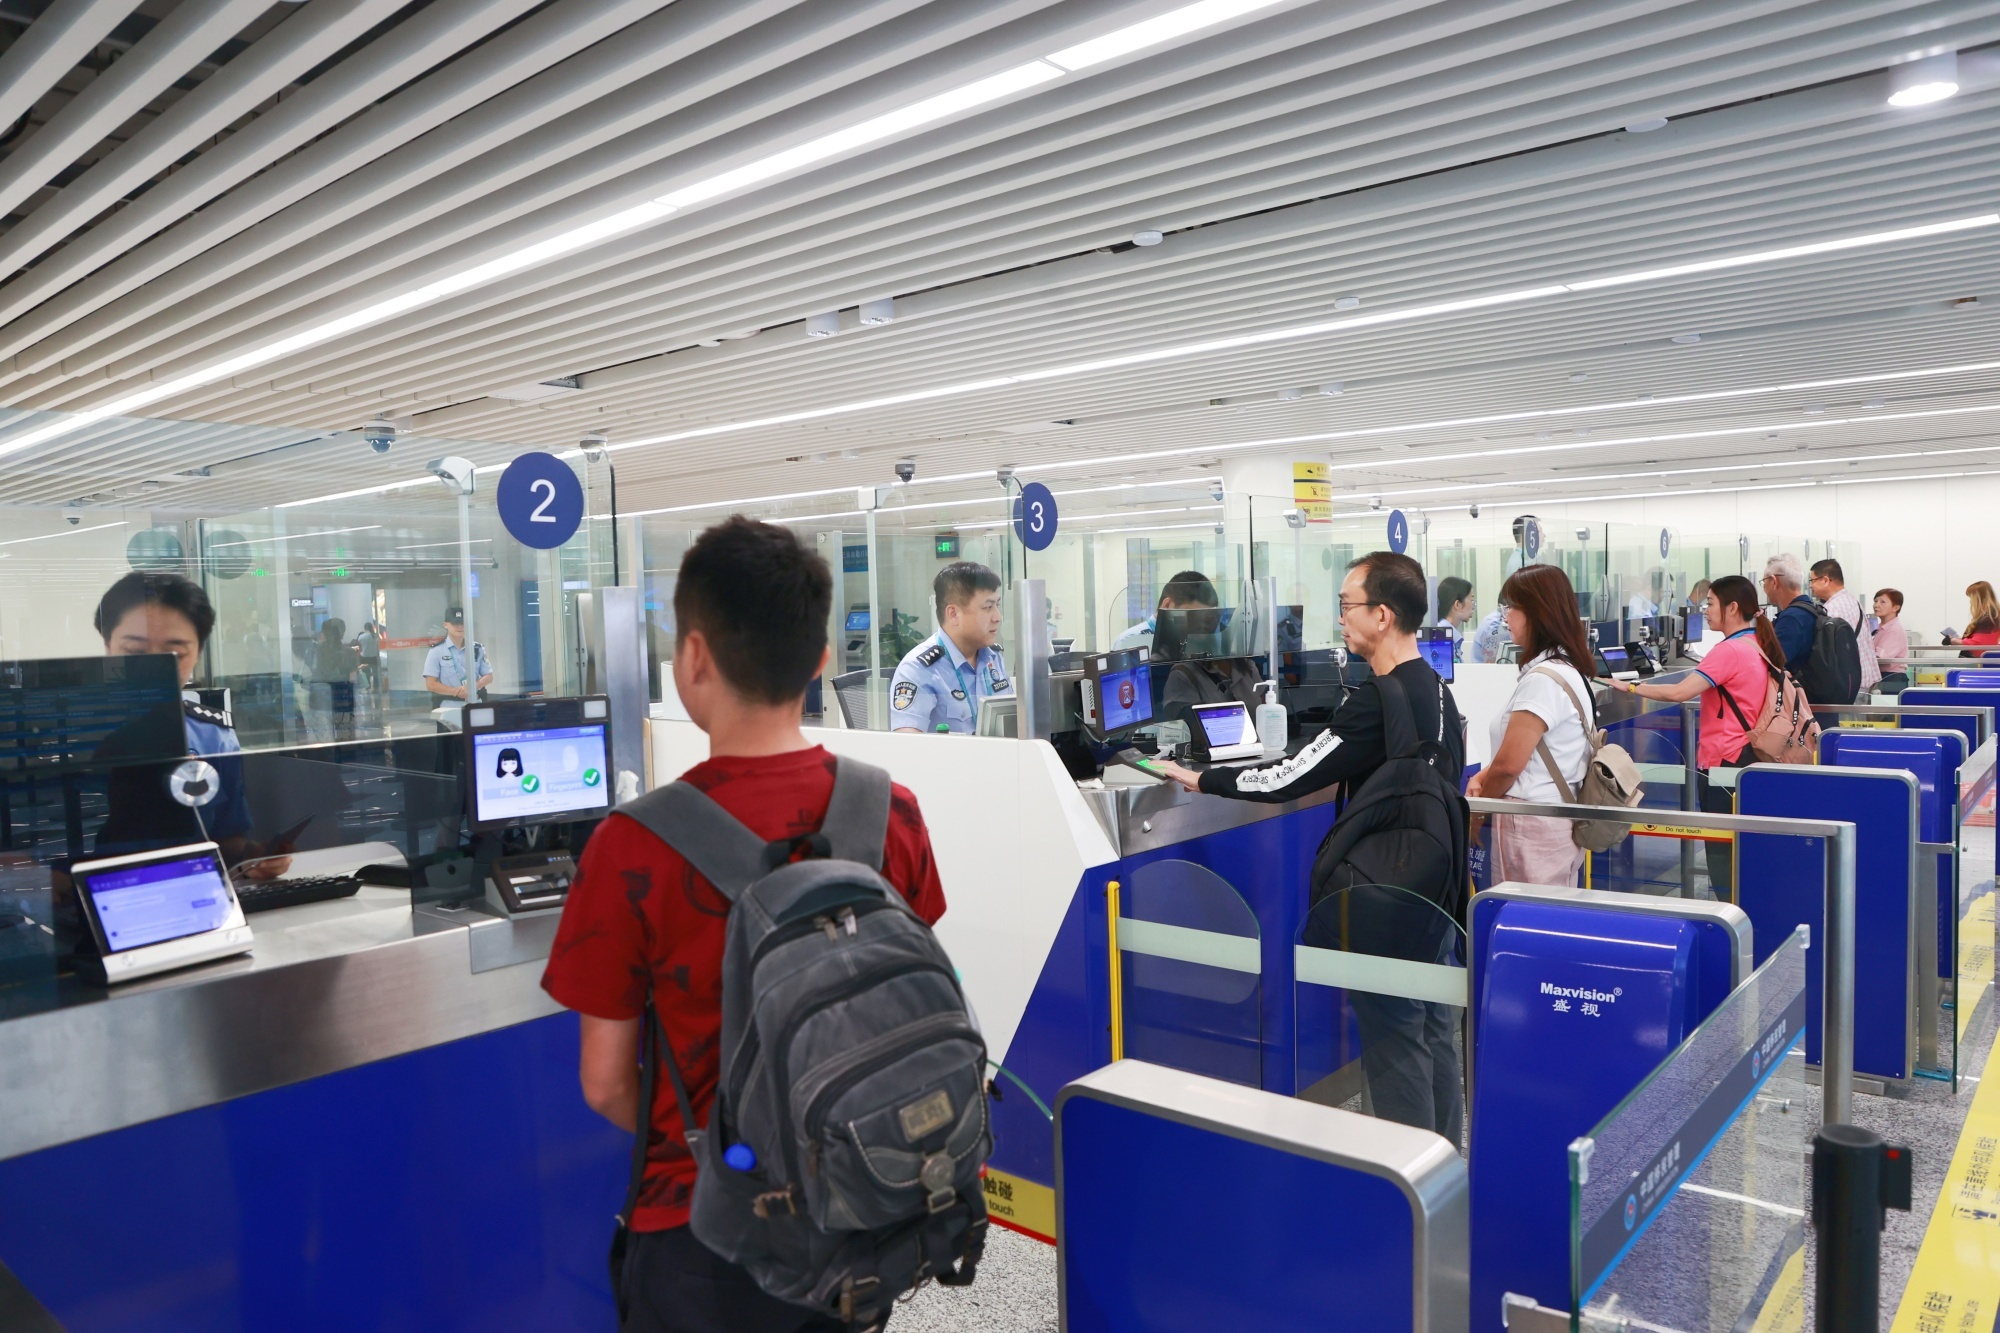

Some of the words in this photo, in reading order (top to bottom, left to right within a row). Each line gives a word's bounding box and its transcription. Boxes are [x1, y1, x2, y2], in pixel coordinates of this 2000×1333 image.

[530, 478, 557, 523] 2
[1030, 501, 1045, 533] 3
[1394, 522, 1402, 544] 4
[1529, 530, 1536, 549] 5
[1662, 536, 1667, 551] 6
[1552, 999, 1601, 1017] 盛视
[988, 1199, 1015, 1217] touch
